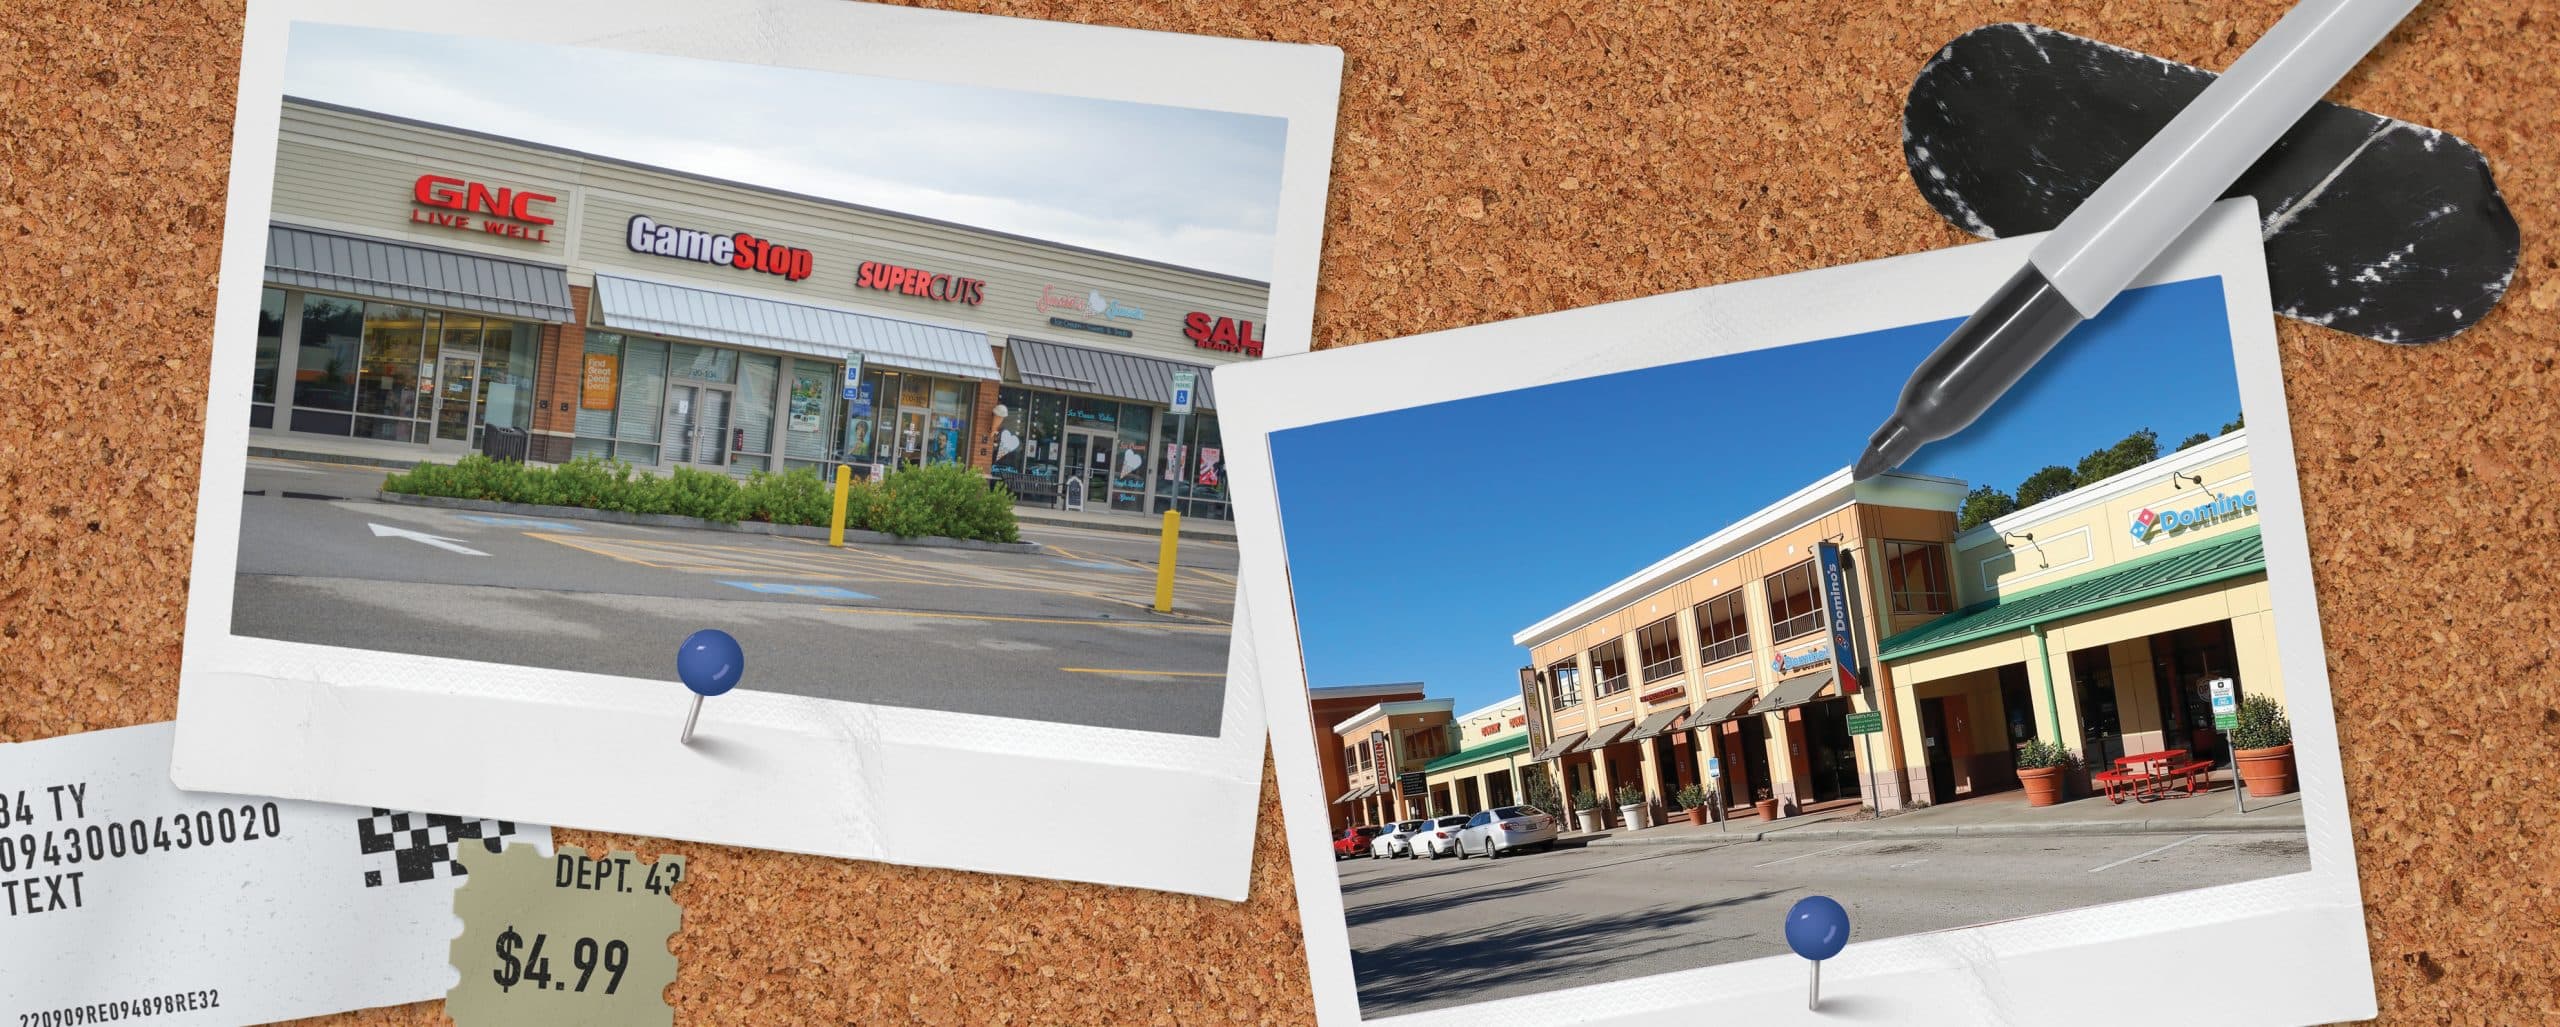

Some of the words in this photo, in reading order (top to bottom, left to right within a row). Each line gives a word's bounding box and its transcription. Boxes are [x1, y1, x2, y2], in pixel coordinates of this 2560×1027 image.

[414, 173, 556, 225] GNC
[412, 208, 470, 230] LIVE
[484, 220, 550, 243] WELL
[627, 214, 813, 281] GameStop
[857, 260, 986, 305] SUPERCUTS
[1183, 311, 1265, 350] SAL
[588, 359, 606, 368] Find
[588, 366, 611, 376] Great
[1827, 563, 1846, 632] Domino's
[47, 782, 86, 821] TY
[0, 802, 281, 872] 0943000430020
[2, 872, 84, 916] TEXT
[556, 854, 632, 893] DEPT.
[493, 925, 629, 994] $4.99
